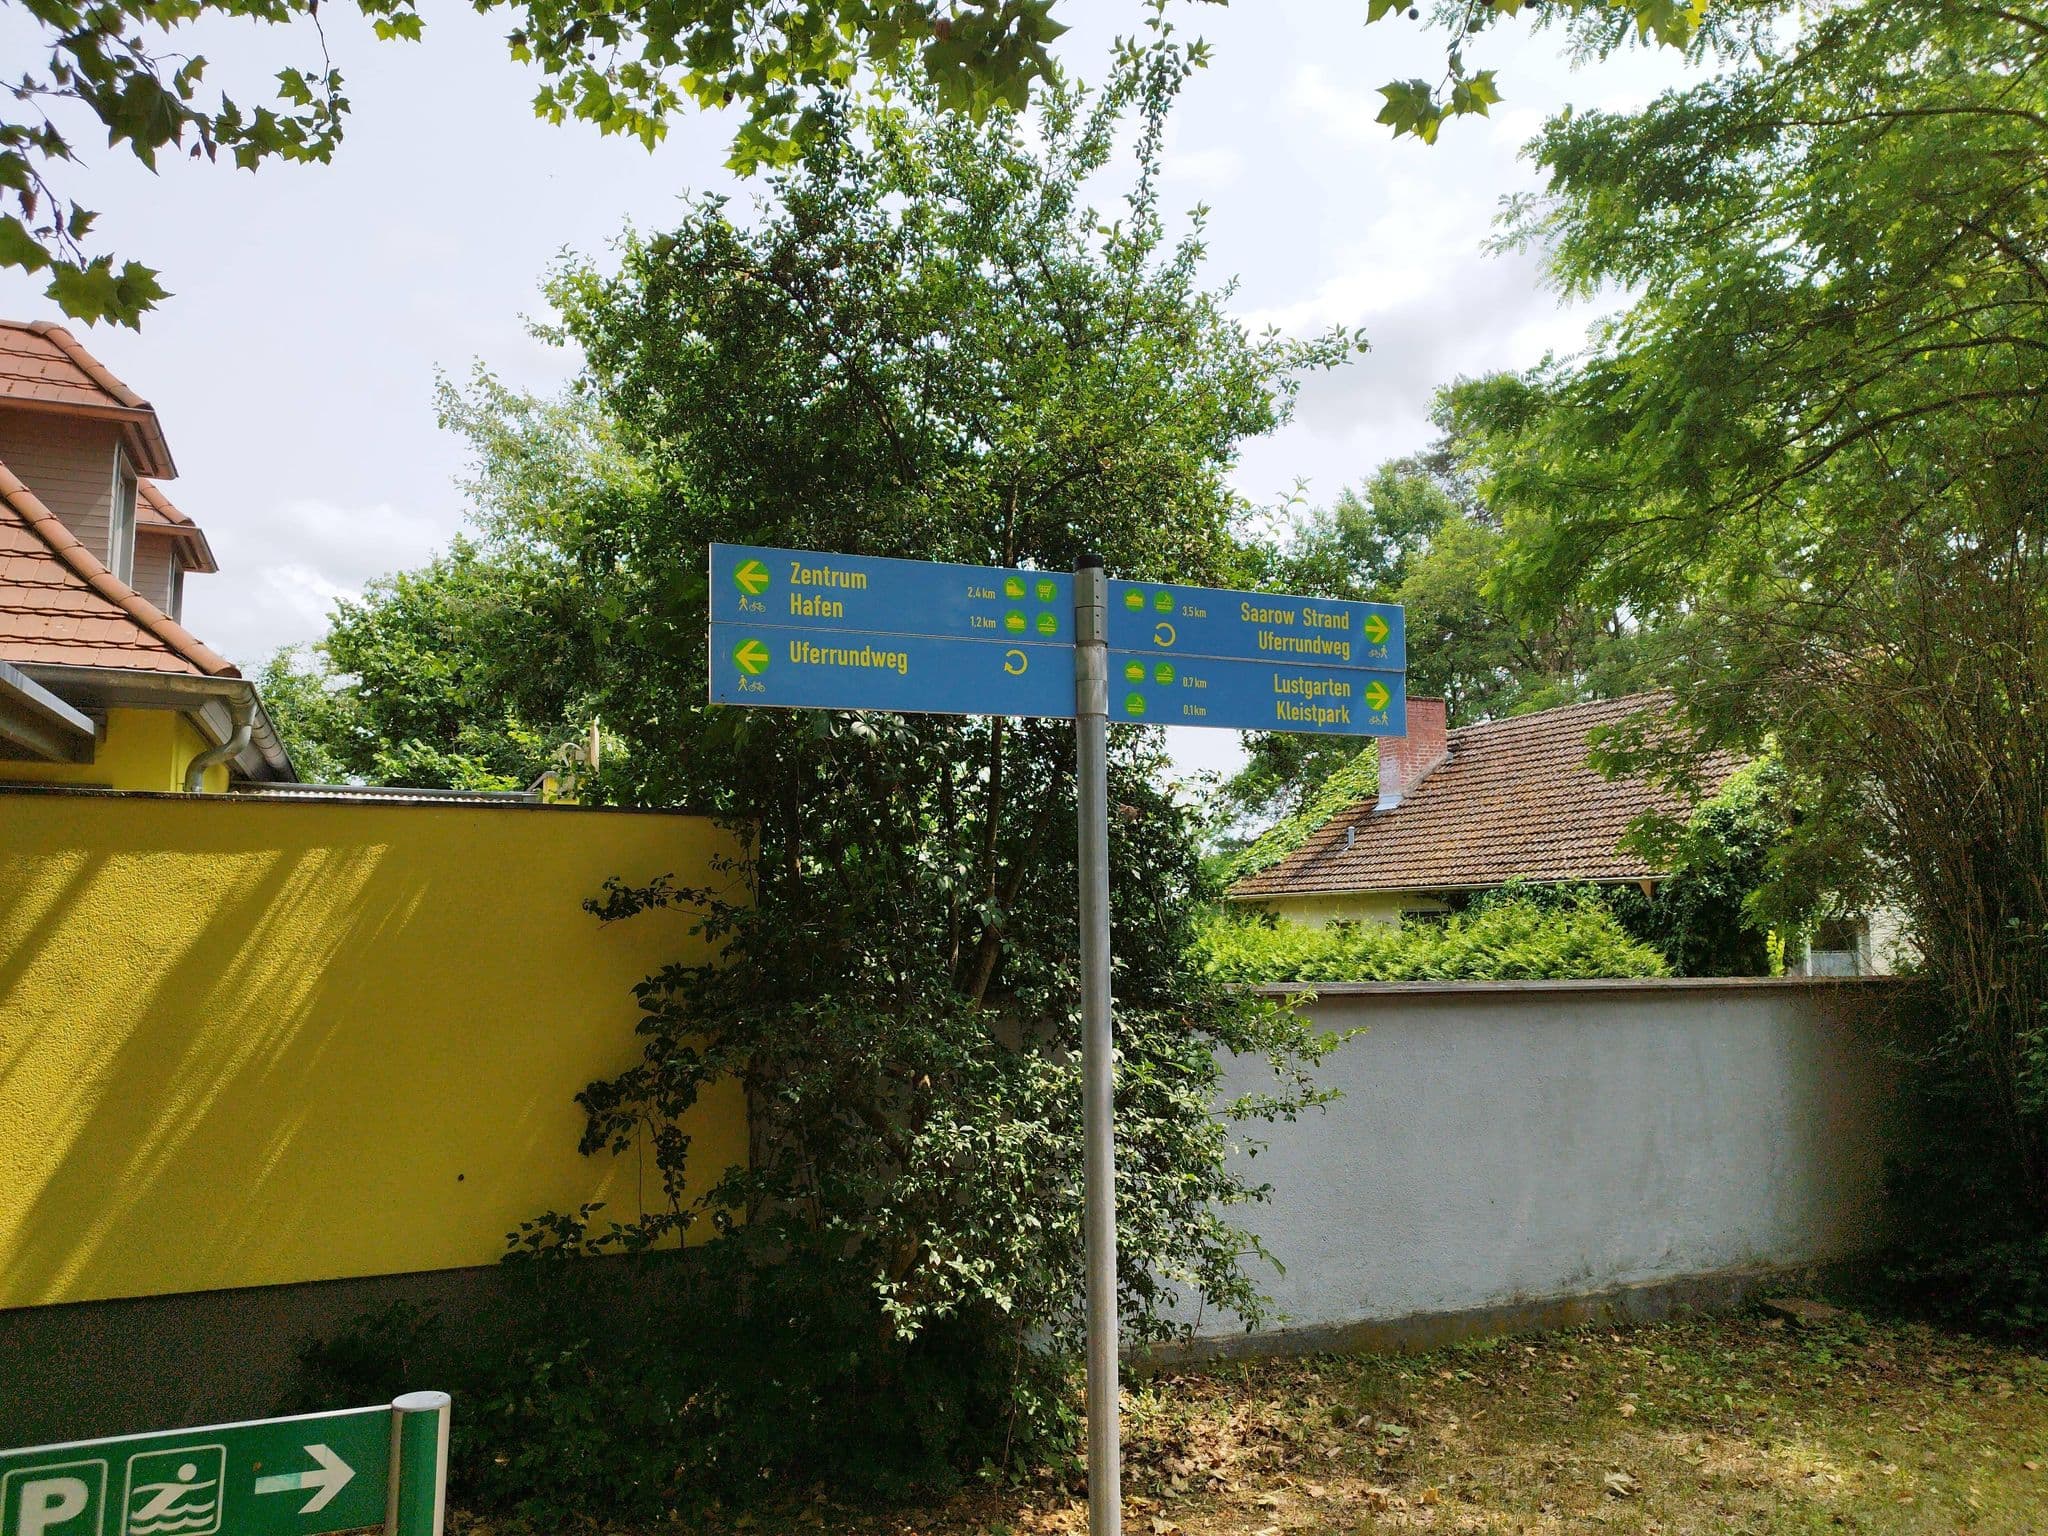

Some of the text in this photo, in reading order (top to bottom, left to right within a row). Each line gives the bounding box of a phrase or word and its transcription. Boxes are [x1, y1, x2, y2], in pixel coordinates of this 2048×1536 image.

[790, 561, 867, 590] Zentrum
[790, 592, 844, 618] Hafen
[1240, 602, 1349, 630] Saarow Strand
[789, 640, 908, 675] Uferrundweg
[1258, 630, 1350, 661] Uferrundweg
[1273, 673, 1351, 699] Lustgarten
[1276, 700, 1350, 727] Kleistpark
[16, 1476, 89, 1536] P
